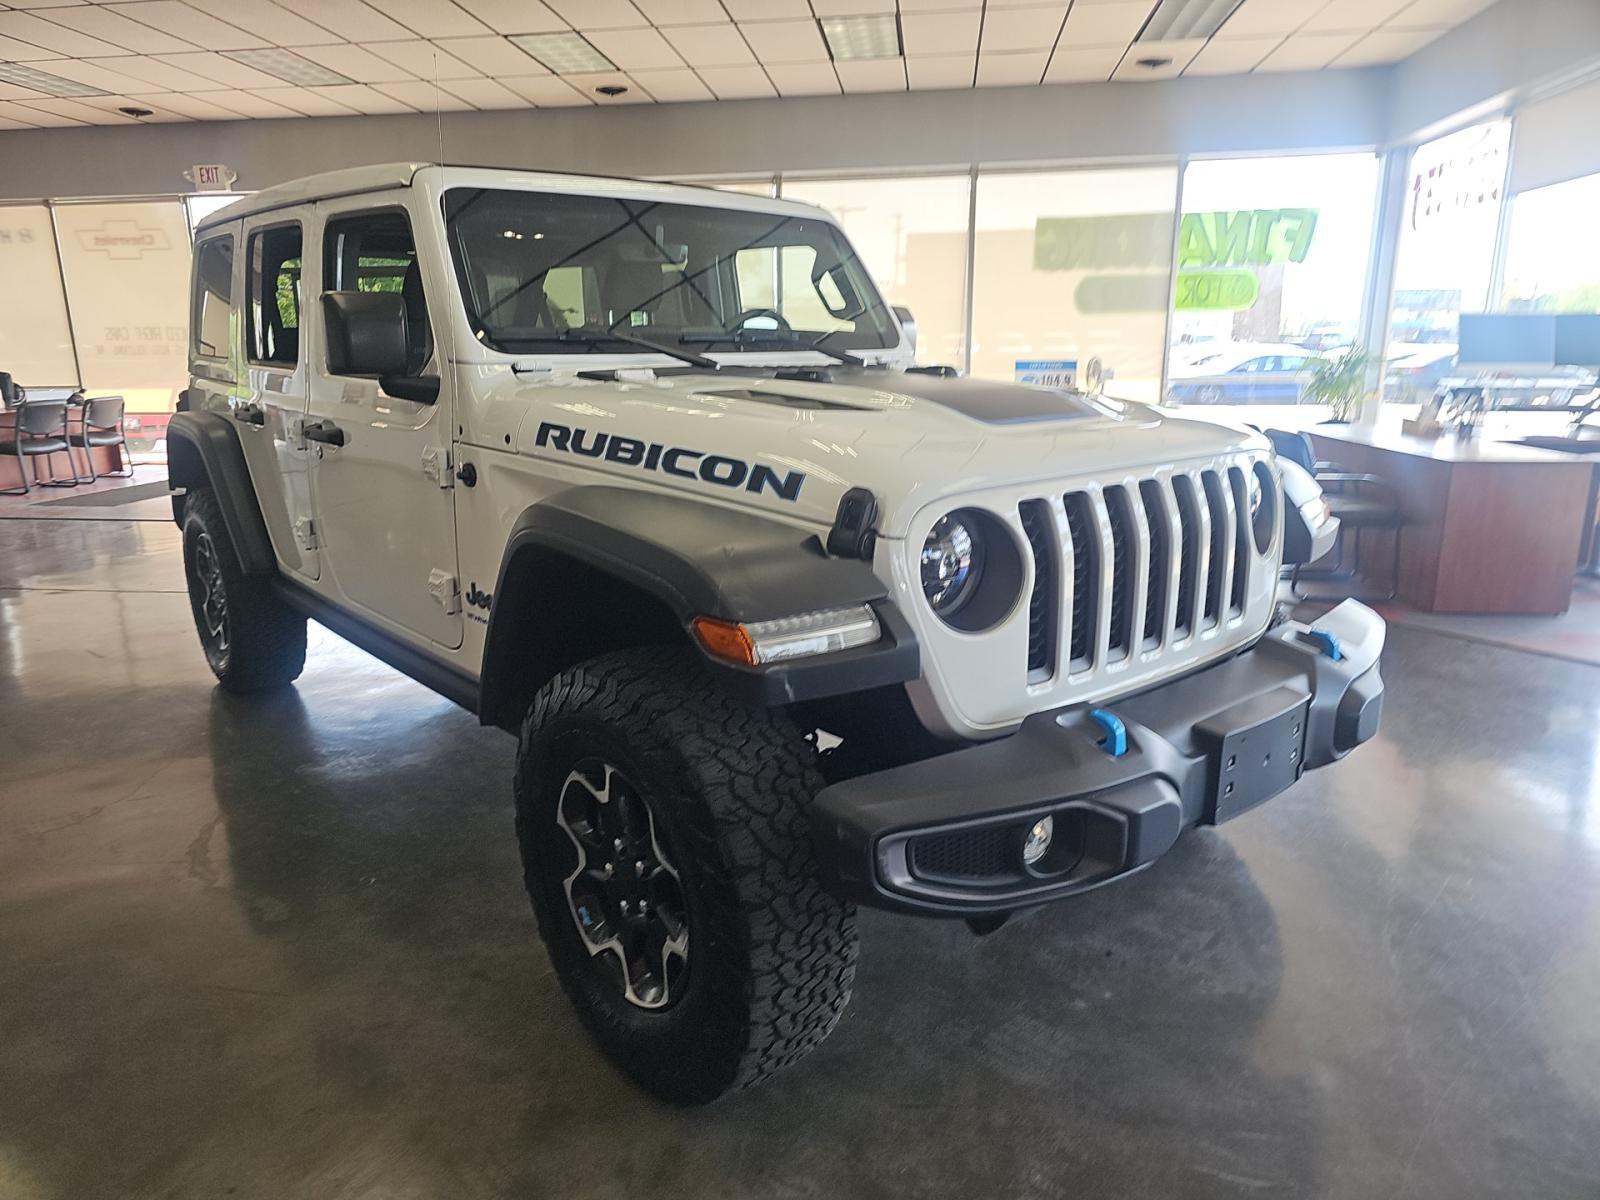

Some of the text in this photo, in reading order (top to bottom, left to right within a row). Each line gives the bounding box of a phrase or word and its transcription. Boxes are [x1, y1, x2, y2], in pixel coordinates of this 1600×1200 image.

[199, 167, 219, 184] EXIT
[535, 421, 806, 502] RUBICON
[465, 582, 493, 611] Jee
